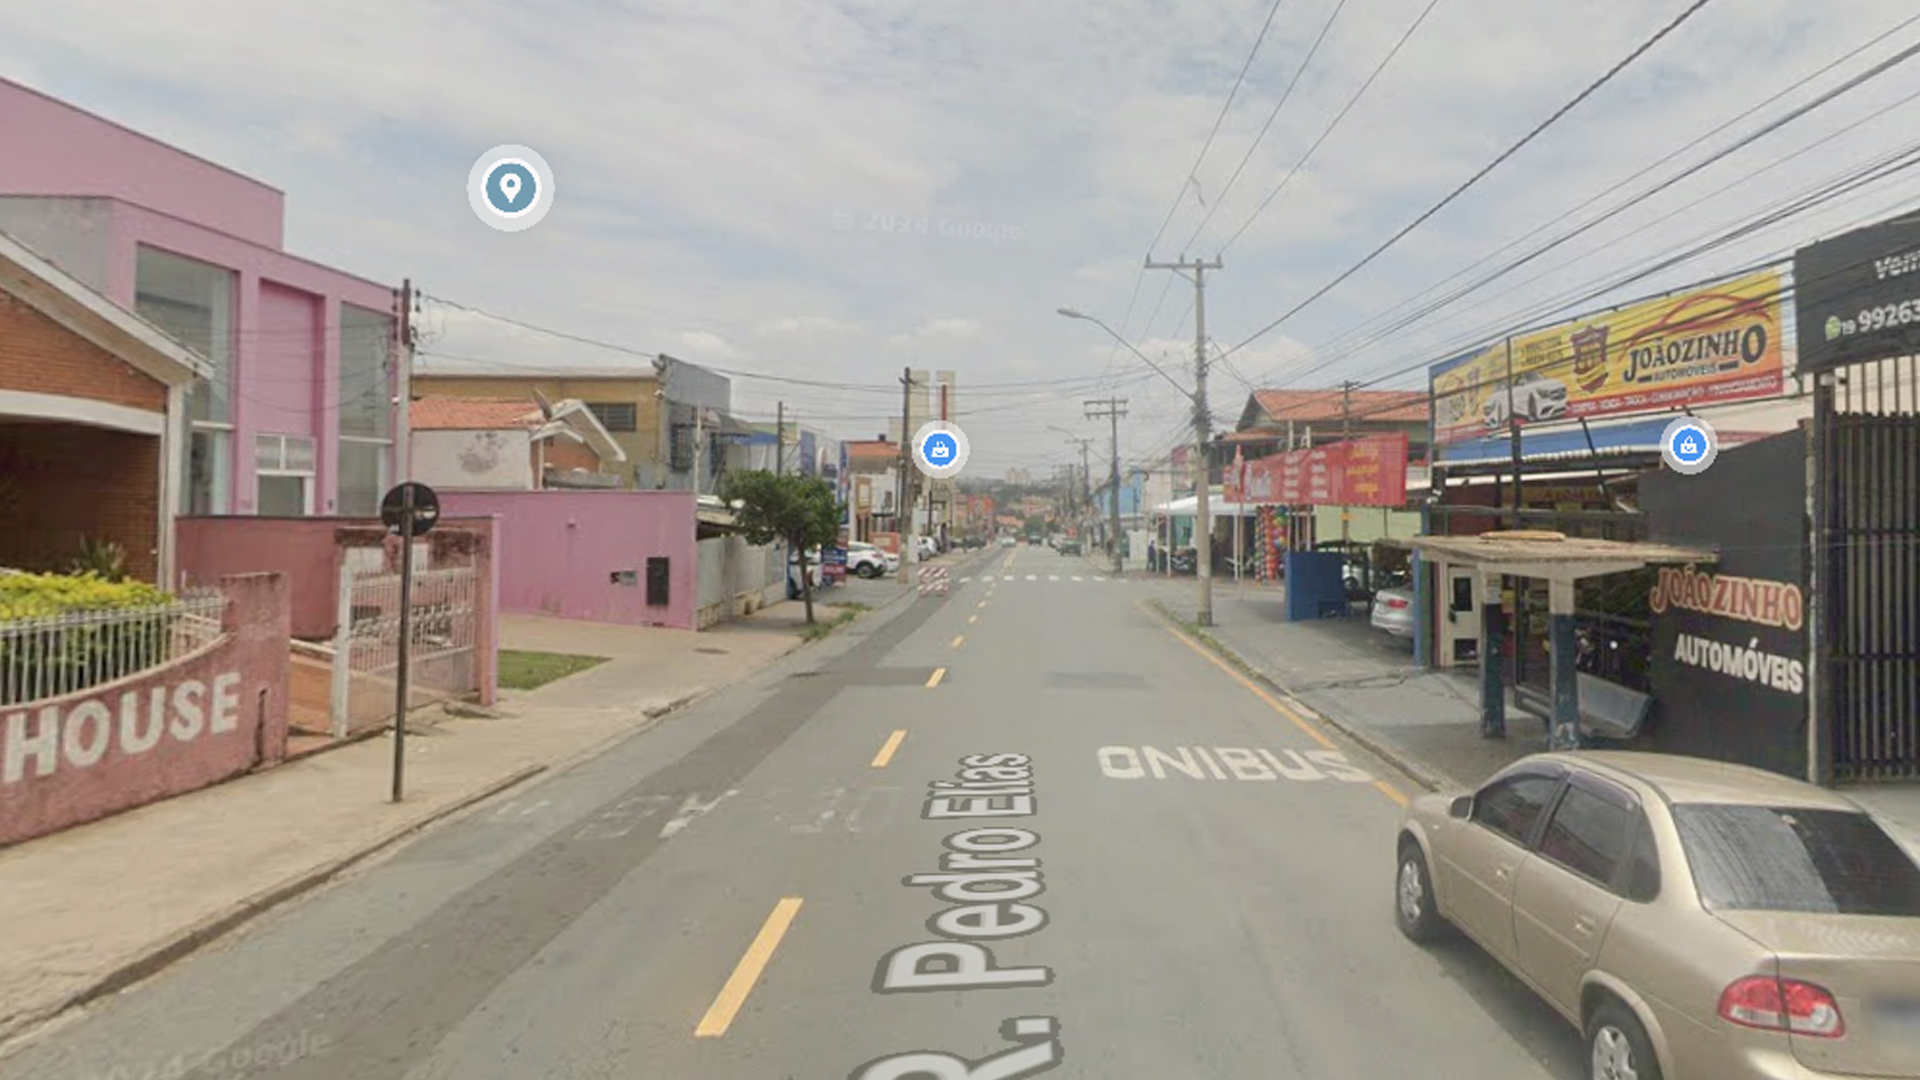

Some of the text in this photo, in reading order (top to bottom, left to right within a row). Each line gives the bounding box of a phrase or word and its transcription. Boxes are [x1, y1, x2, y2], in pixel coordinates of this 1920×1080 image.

[1624, 324, 1767, 382] JOÃOZINHO
[1650, 563, 1803, 631] JOÃOZINHO
[1674, 633, 1804, 694] AUTOMÓVEIS
[4, 672, 242, 784] HOUSE
[1097, 745, 1374, 783] ONIBUS
